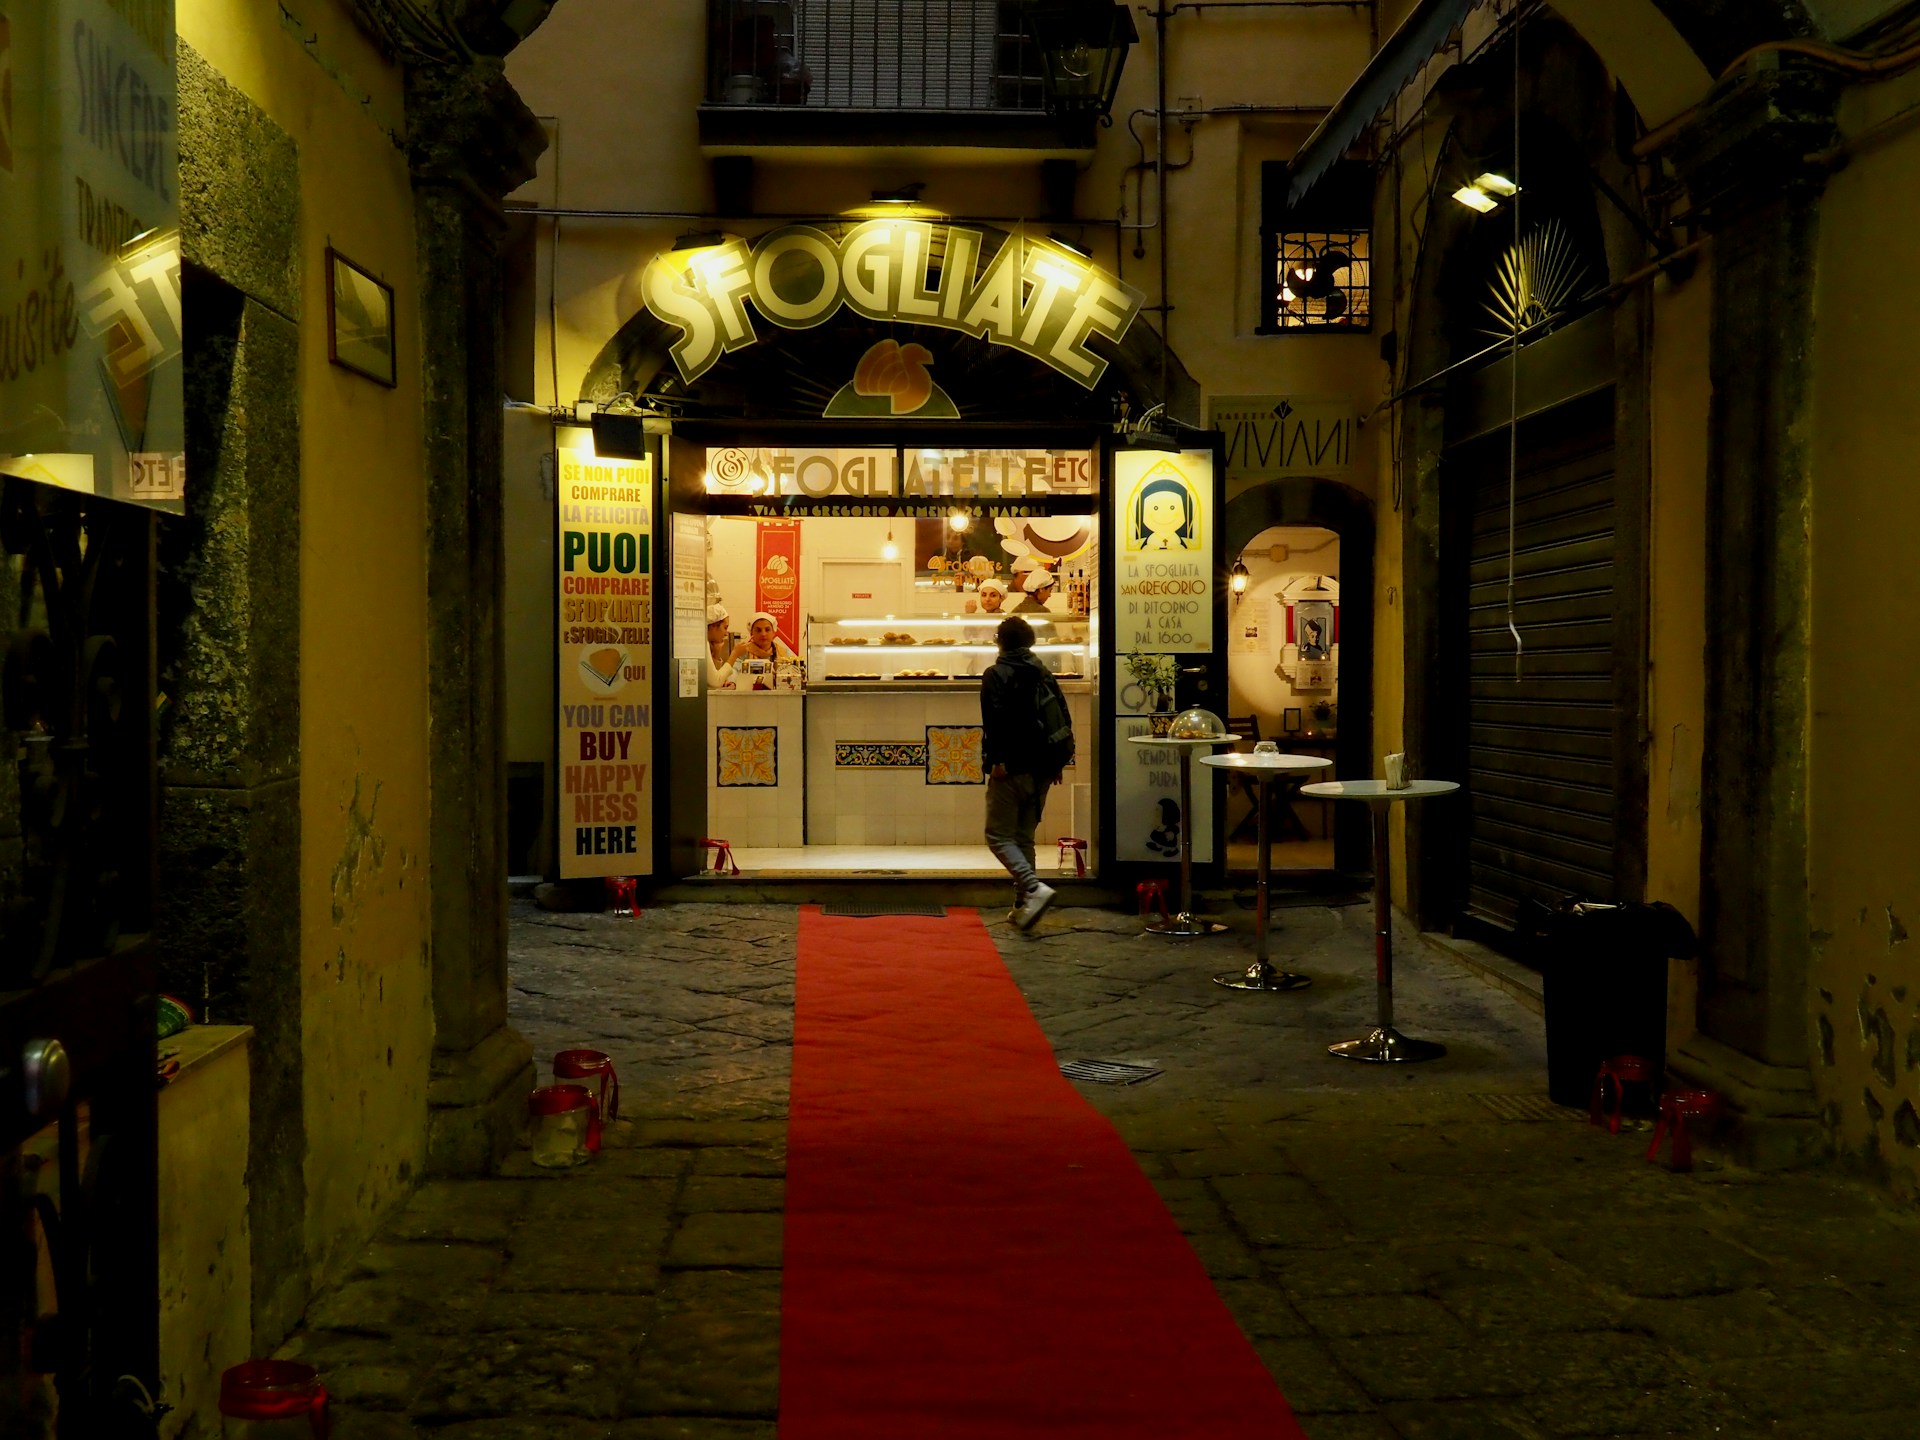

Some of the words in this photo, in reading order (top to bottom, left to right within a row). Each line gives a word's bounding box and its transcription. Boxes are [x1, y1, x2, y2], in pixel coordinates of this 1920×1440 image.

[645, 218, 1138, 386] SFOGLIATE
[0, 246, 80, 384] uisite
[1216, 418, 1350, 467] VIVIANI
[564, 464, 581, 481] SE
[584, 465, 613, 483] NON
[617, 467, 649, 485] PUOI
[752, 455, 1048, 500] SFOGLIATELLE
[1053, 457, 1088, 483] ETC
[571, 485, 641, 502] COMPRARE
[563, 504, 582, 523] LA
[585, 504, 649, 526] FELICITÀ
[753, 504, 777, 516] VIA
[783, 505, 808, 516] SAN
[812, 505, 889, 517] GREGORIO
[895, 505, 957, 517] ARMENO
[964, 505, 983, 517] 24
[990, 506, 1046, 517] NAPOLI
[564, 531, 649, 574] PUOI
[1128, 564, 1139, 578] LA
[1145, 564, 1200, 578] SFOGLIATA
[563, 576, 650, 596] COMPRARE
[1121, 584, 1137, 595] SAN
[1138, 580, 1206, 595] GREGORIO
[1129, 601, 1138, 614] DI
[1144, 601, 1199, 614] RITORNO
[1146, 617, 1152, 629] A
[1159, 616, 1182, 629] CASA
[1135, 632, 1152, 644] DAL
[1159, 632, 1193, 644] 1600
[623, 665, 646, 681] QUI
[563, 704, 604, 728] YOU
[609, 704, 649, 728] CAN
[580, 731, 632, 761] BUY
[1137, 749, 1180, 765] SEMPLI
[565, 764, 647, 794] HAPPY
[575, 793, 638, 823] NESS
[576, 826, 636, 855] HERE
